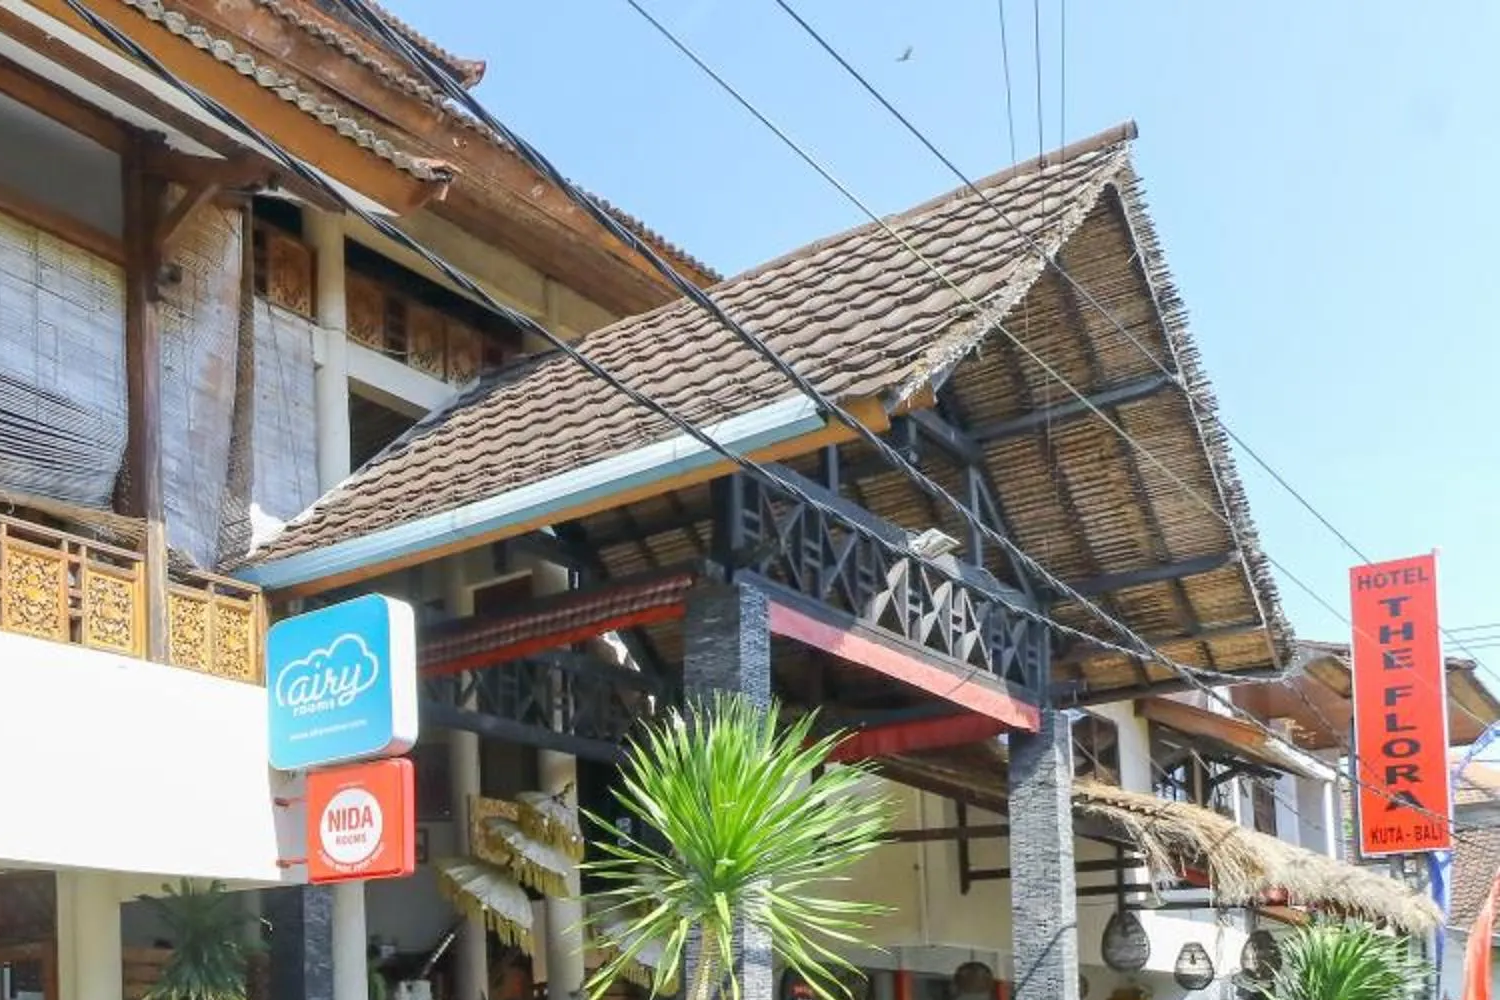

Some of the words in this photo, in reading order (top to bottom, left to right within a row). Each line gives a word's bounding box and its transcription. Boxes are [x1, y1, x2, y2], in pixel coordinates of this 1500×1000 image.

[1357, 566, 1429, 592] HOTEL
[1378, 595, 1414, 671] THE
[287, 661, 362, 707] airy
[1381, 684, 1424, 812] FLORA
[327, 804, 375, 833] NIDA
[1370, 824, 1404, 845] KUTA
